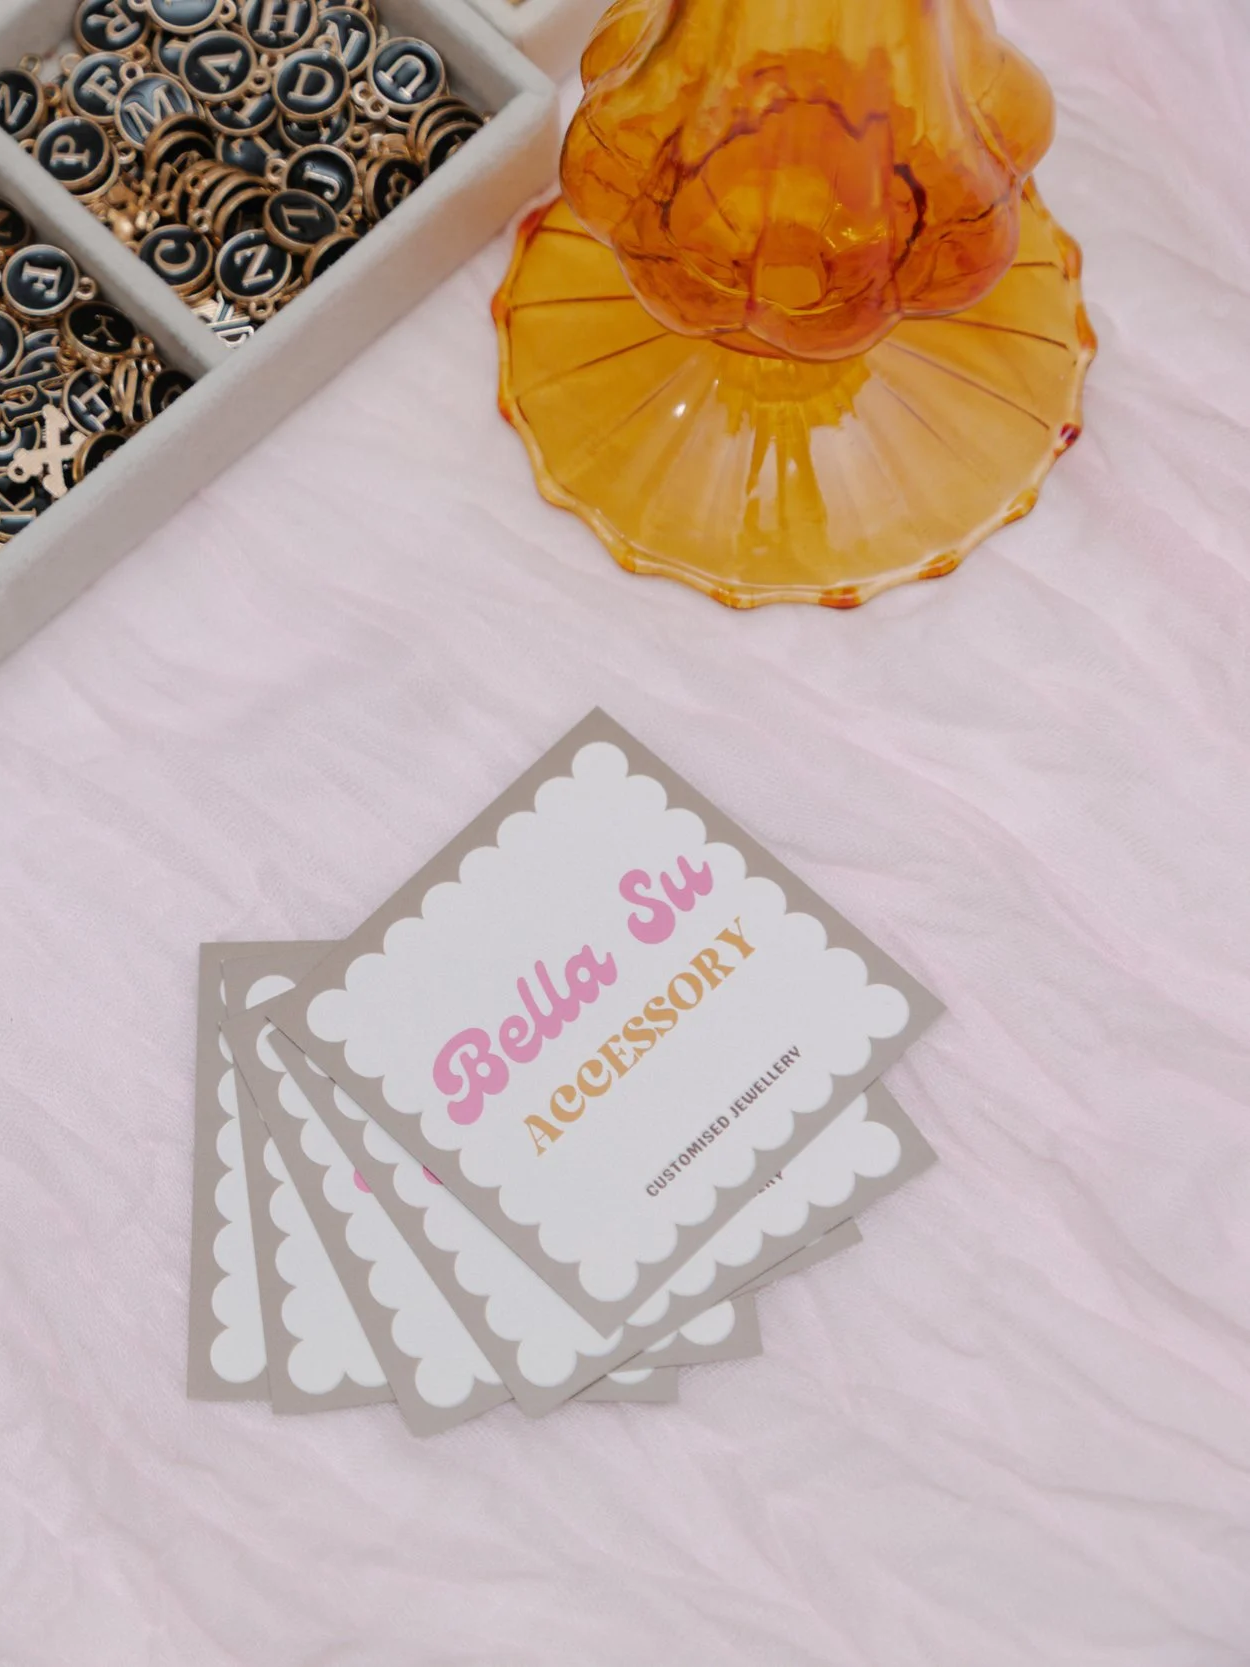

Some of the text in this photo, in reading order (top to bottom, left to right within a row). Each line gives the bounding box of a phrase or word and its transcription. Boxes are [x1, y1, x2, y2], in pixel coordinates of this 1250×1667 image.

[86, 0, 141, 43] R
[253, 0, 300, 41] H
[287, 62, 335, 102] D
[376, 54, 428, 101] U
[50, 135, 91, 170] P
[153, 238, 198, 276] C
[82, 313, 123, 347] Y
[433, 855, 714, 1126] Bella Su
[523, 916, 756, 1157] ACCESSORY
[645, 1045, 803, 1198] CUSTOMISED JEWELLERY
